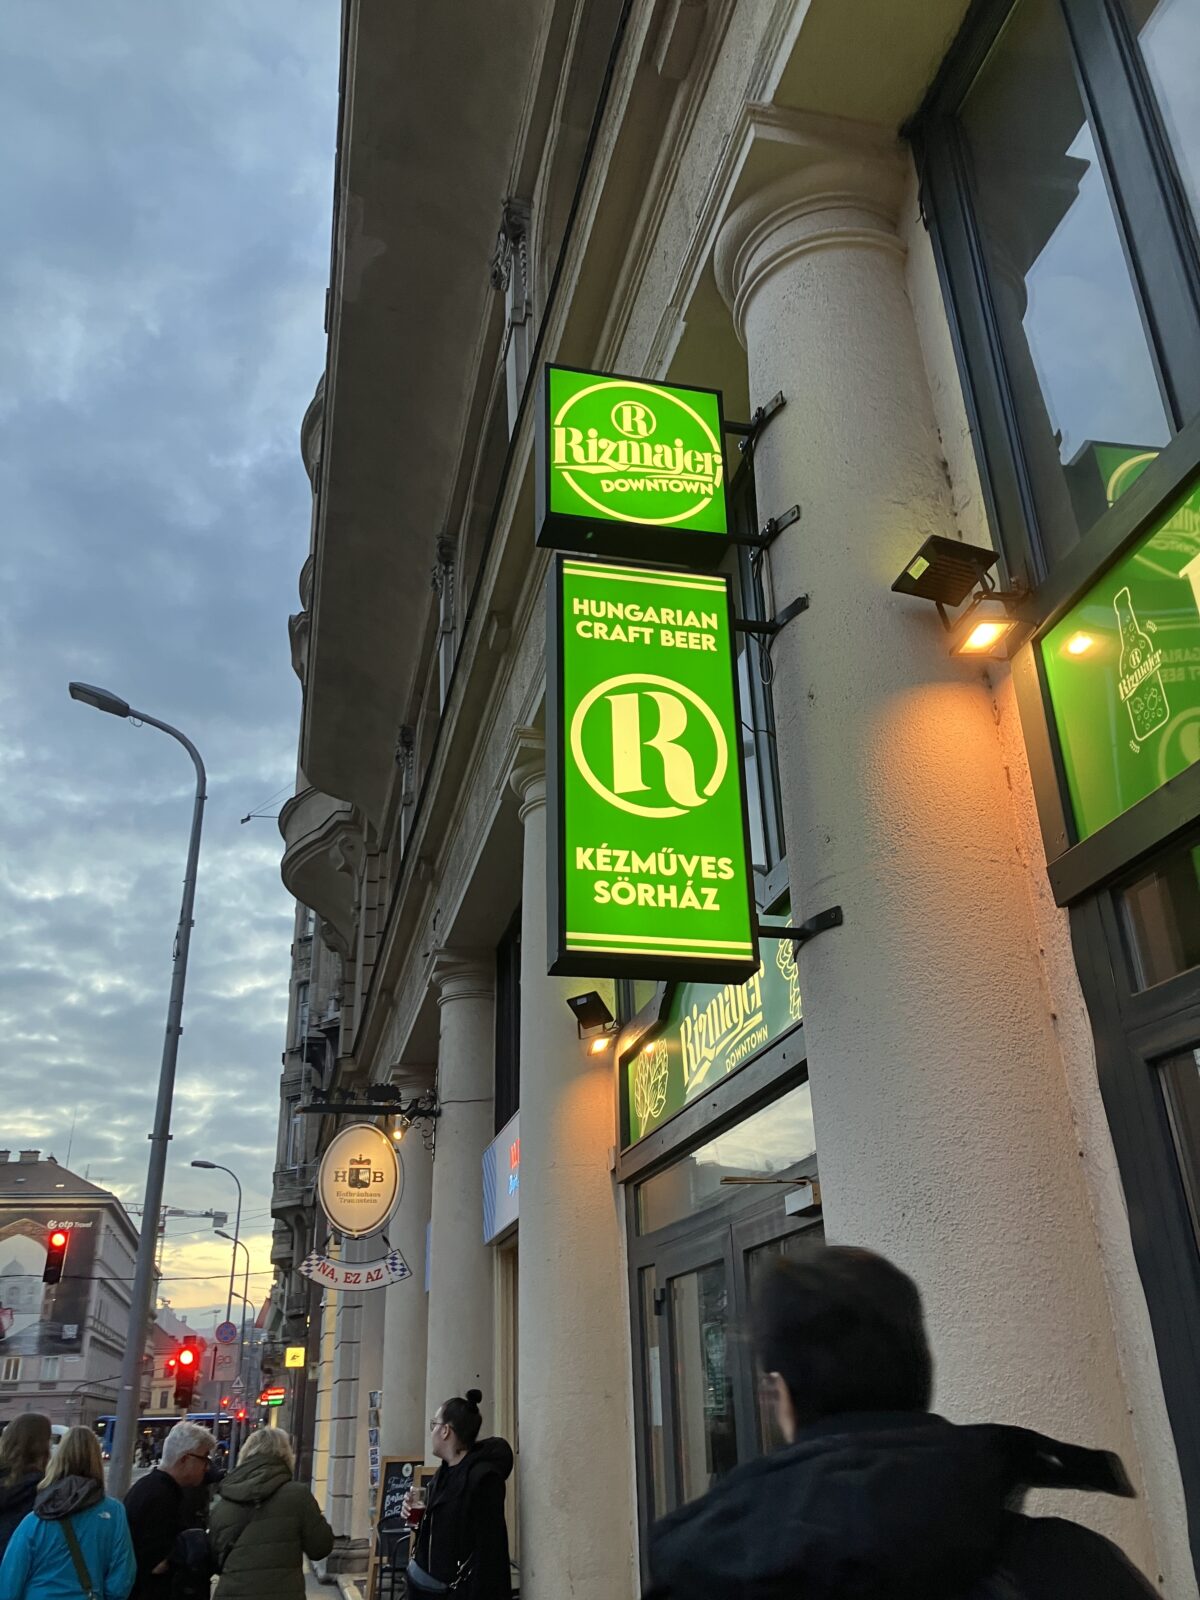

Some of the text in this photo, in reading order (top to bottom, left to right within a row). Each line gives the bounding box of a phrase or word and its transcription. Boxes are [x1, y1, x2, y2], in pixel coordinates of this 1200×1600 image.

[620, 404, 651, 437] R
[552, 426, 723, 477] Rizmajer
[600, 478, 714, 496] DOWNTOWN
[572, 597, 718, 630] HUNGARIAN
[575, 620, 718, 652] CRAFT BEER
[604, 691, 708, 807] R
[575, 842, 735, 880] KÉZMŰVES
[593, 876, 721, 911] SÖRHÁZ
[680, 959, 765, 1088] Rizmajer
[725, 1024, 769, 1073] DOWNTOWN
[334, 1170, 384, 1183] H B
[318, 1262, 338, 1283] NA,
[343, 1272, 361, 1285] EZ
